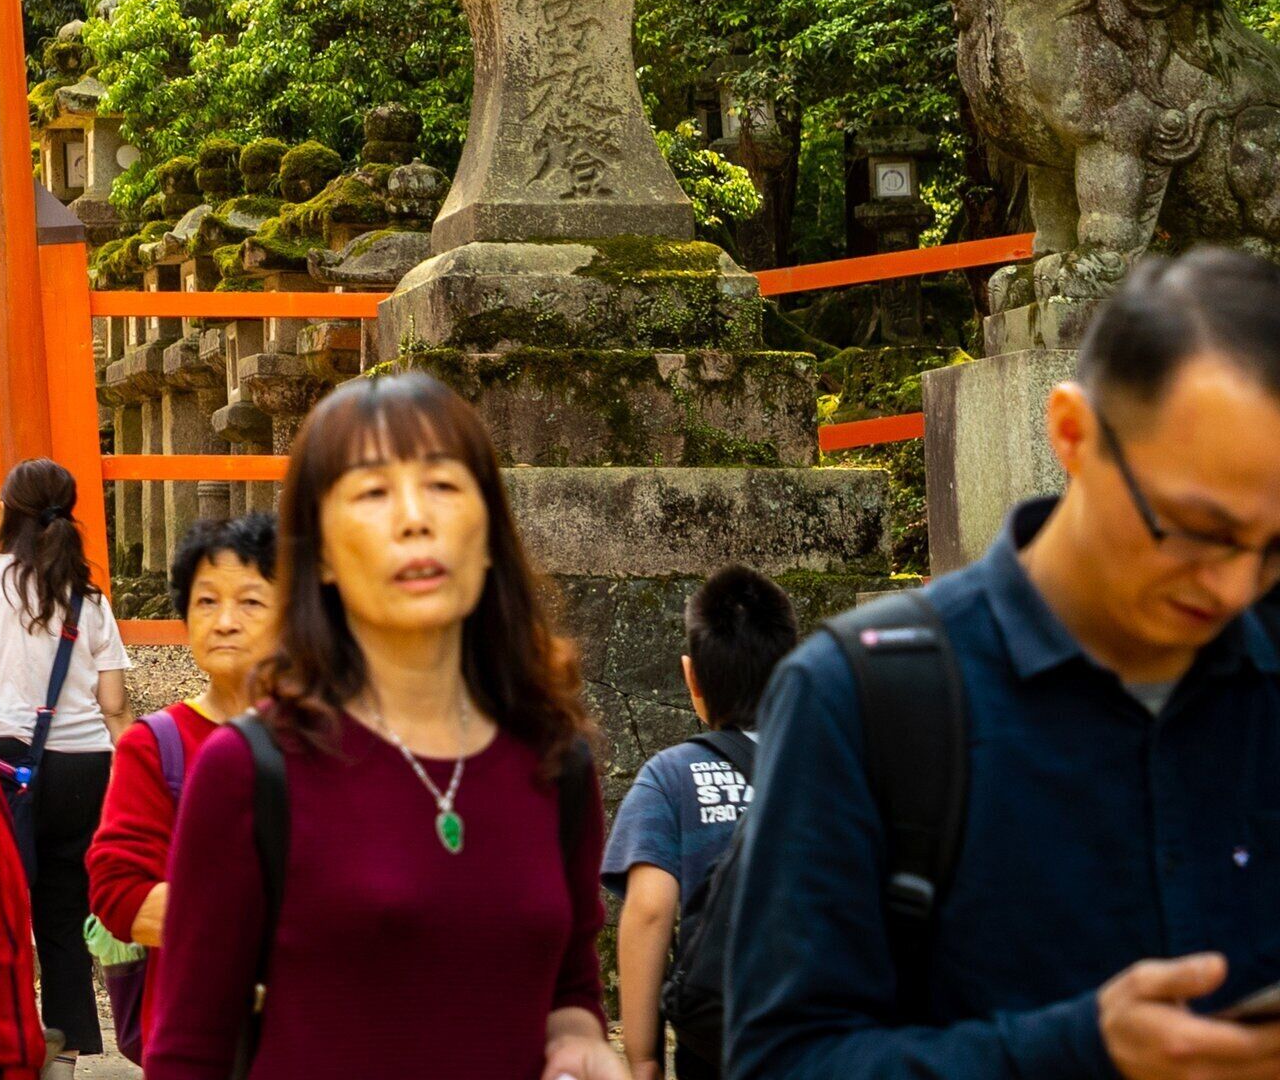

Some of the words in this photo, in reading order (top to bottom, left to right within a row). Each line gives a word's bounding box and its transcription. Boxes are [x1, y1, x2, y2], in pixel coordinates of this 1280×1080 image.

[689, 761, 732, 772] COAS
[692, 771, 746, 786] UNI
[700, 804, 737, 823] 1790
